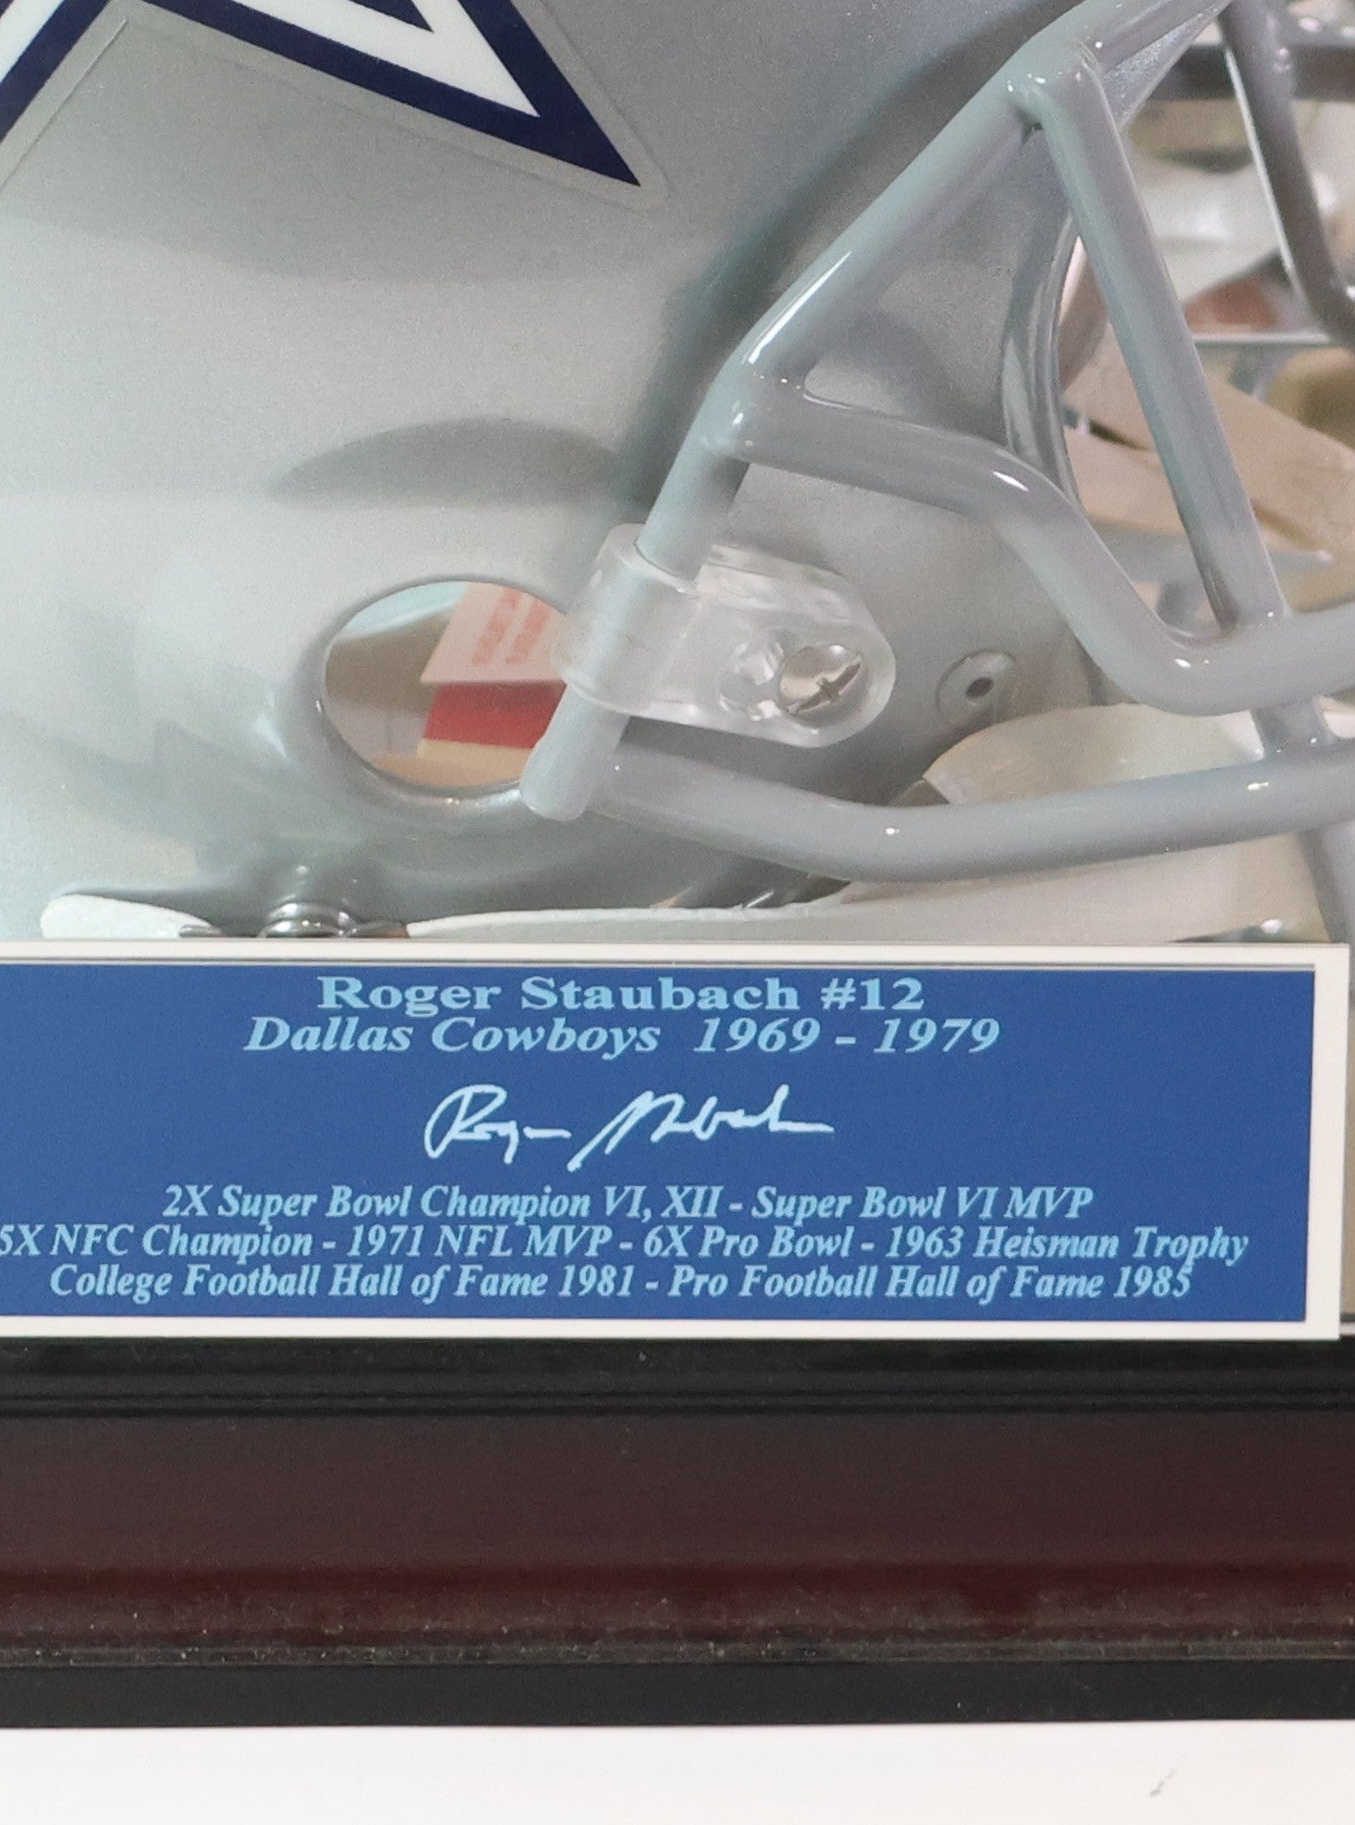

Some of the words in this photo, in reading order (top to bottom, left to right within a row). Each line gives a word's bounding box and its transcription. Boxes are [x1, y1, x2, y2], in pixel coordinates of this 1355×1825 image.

[316, 975, 502, 1019] Roger
[521, 975, 801, 1011] Staubach
[820, 977, 925, 1011] #12
[242, 1016, 414, 1052] Dallas
[431, 1016, 661, 1061] Cowboys
[693, 1016, 821, 1053] 1969
[873, 1017, 1000, 1054] 1979
[161, 1184, 214, 1218] 2X
[218, 1184, 320, 1227] Super
[325, 1184, 414, 1218] Bowl
[420, 1184, 591, 1228] Champion
[603, 1185, 649, 1225] VI,
[660, 1185, 724, 1219] XII
[750, 1185, 853, 1229] Super
[859, 1186, 947, 1220] Bowl
[957, 1186, 1000, 1220] VI
[1003, 1186, 1094, 1220] MVP
[49, 1223, 135, 1257] NFC
[141, 1223, 313, 1266] Champion
[346, 1223, 425, 1257] 1971
[433, 1224, 513, 1257] NFL
[522, 1224, 613, 1258] MVP
[643, 1224, 694, 1258] 6X
[697, 1224, 759, 1258] Pro
[769, 1225, 855, 1259] Bowl
[885, 1224, 965, 1259] 1963
[972, 1225, 1120, 1259] Heisman
[1132, 1225, 1249, 1268] Trophy
[49, 1263, 173, 1305] College
[181, 1263, 321, 1297] Football
[327, 1263, 404, 1297] Hall
[410, 1264, 452, 1305] of
[453, 1264, 549, 1298] Fame
[557, 1264, 635, 1298] 1981
[666, 1264, 729, 1298] Pro
[739, 1264, 879, 1298] Football
[884, 1264, 960, 1298] Hall
[965, 1265, 1008, 1307] of
[1009, 1265, 1105, 1299] Fame
[1113, 1265, 1192, 1299] 1985
